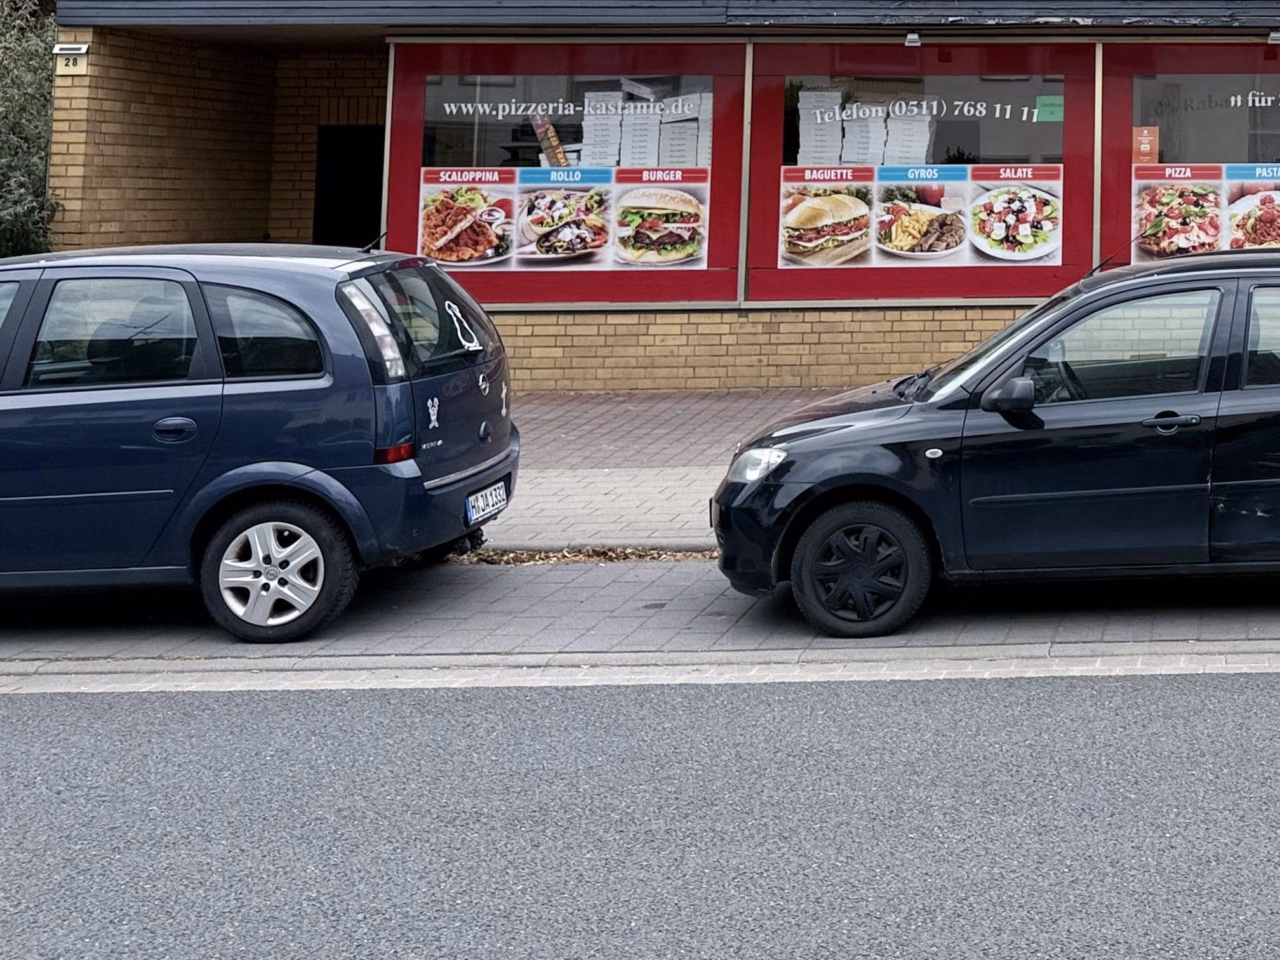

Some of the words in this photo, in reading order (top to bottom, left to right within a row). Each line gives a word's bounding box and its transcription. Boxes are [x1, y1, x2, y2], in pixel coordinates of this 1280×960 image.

[64, 57, 78, 67] 28
[1247, 90, 1275, 108] für
[443, 98, 694, 120] www.pizzeria-kastanie.de
[812, 101, 885, 124] Telefon
[888, 99, 948, 118] (0511)
[953, 100, 987, 117] 768
[993, 103, 1012, 119] 11
[1021, 106, 1039, 123] 11
[439, 170, 500, 182] SCALOPPINA
[550, 170, 582, 182] ROLLO
[642, 170, 683, 182] BURGER
[804, 169, 853, 180] BAGUETTE
[907, 168, 939, 179] GYROS
[999, 167, 1033, 179] SALATE
[1165, 166, 1192, 178] PIZZA
